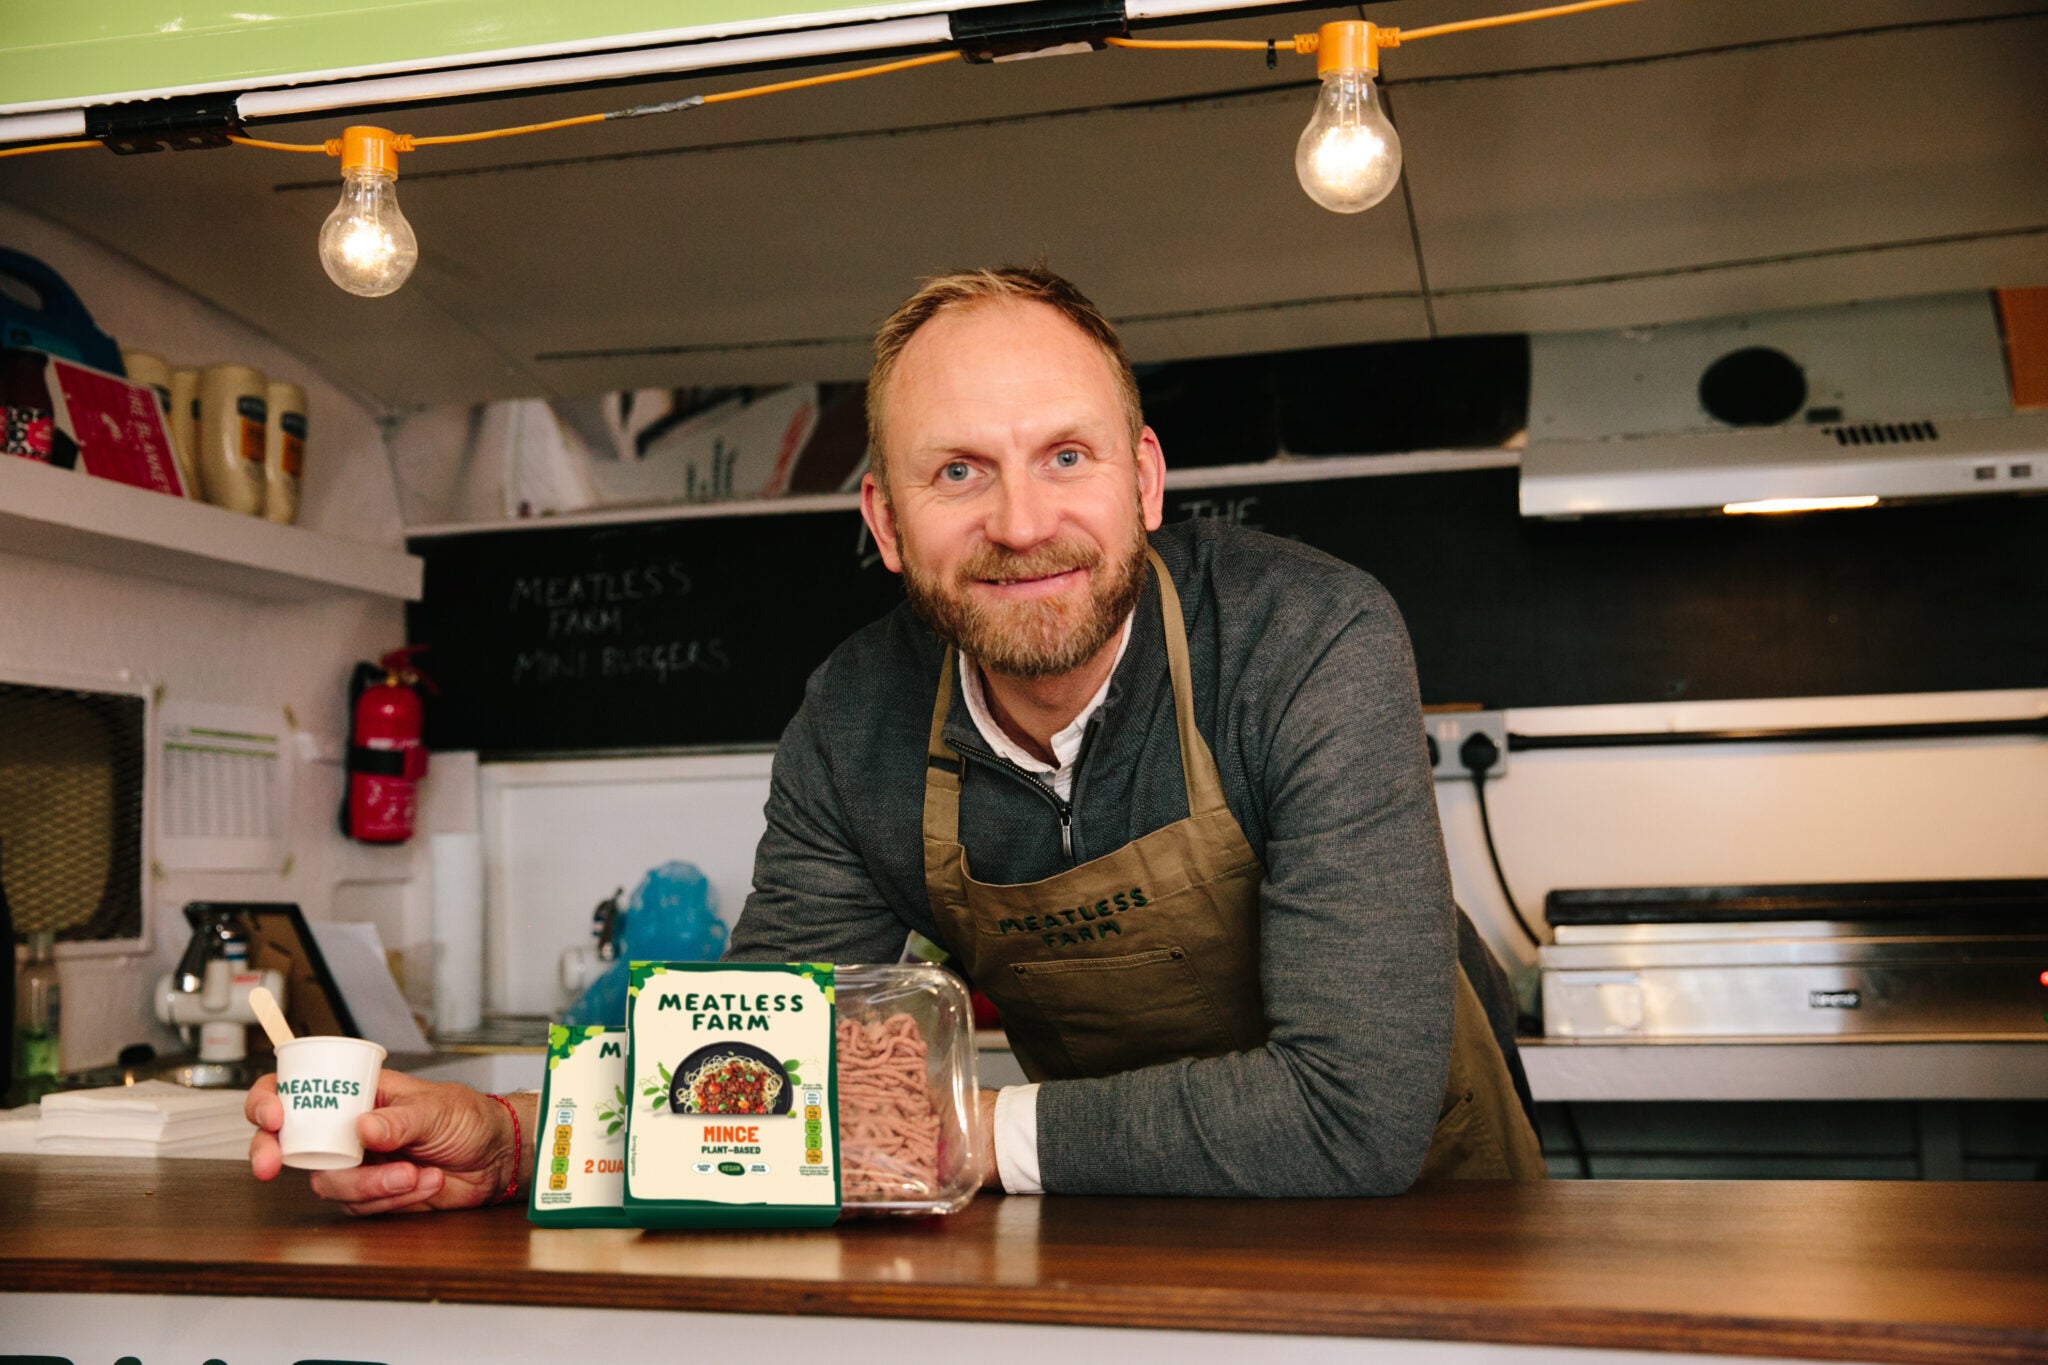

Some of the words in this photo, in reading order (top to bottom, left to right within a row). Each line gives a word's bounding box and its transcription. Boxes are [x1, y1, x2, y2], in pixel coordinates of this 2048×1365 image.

[508, 560, 692, 612] MEATLESS
[998, 887, 1148, 935] MEATLESS
[1042, 920, 1121, 947] FARM
[658, 993, 803, 1012] MEATLESS
[692, 1013, 769, 1031] FARM
[276, 1079, 360, 1096] MEATLESS
[293, 1095, 339, 1110] FARM
[703, 1125, 759, 1143] MINCE
[701, 1146, 761, 1154] PLANT-BASED
[584, 1159, 594, 1174] 2
